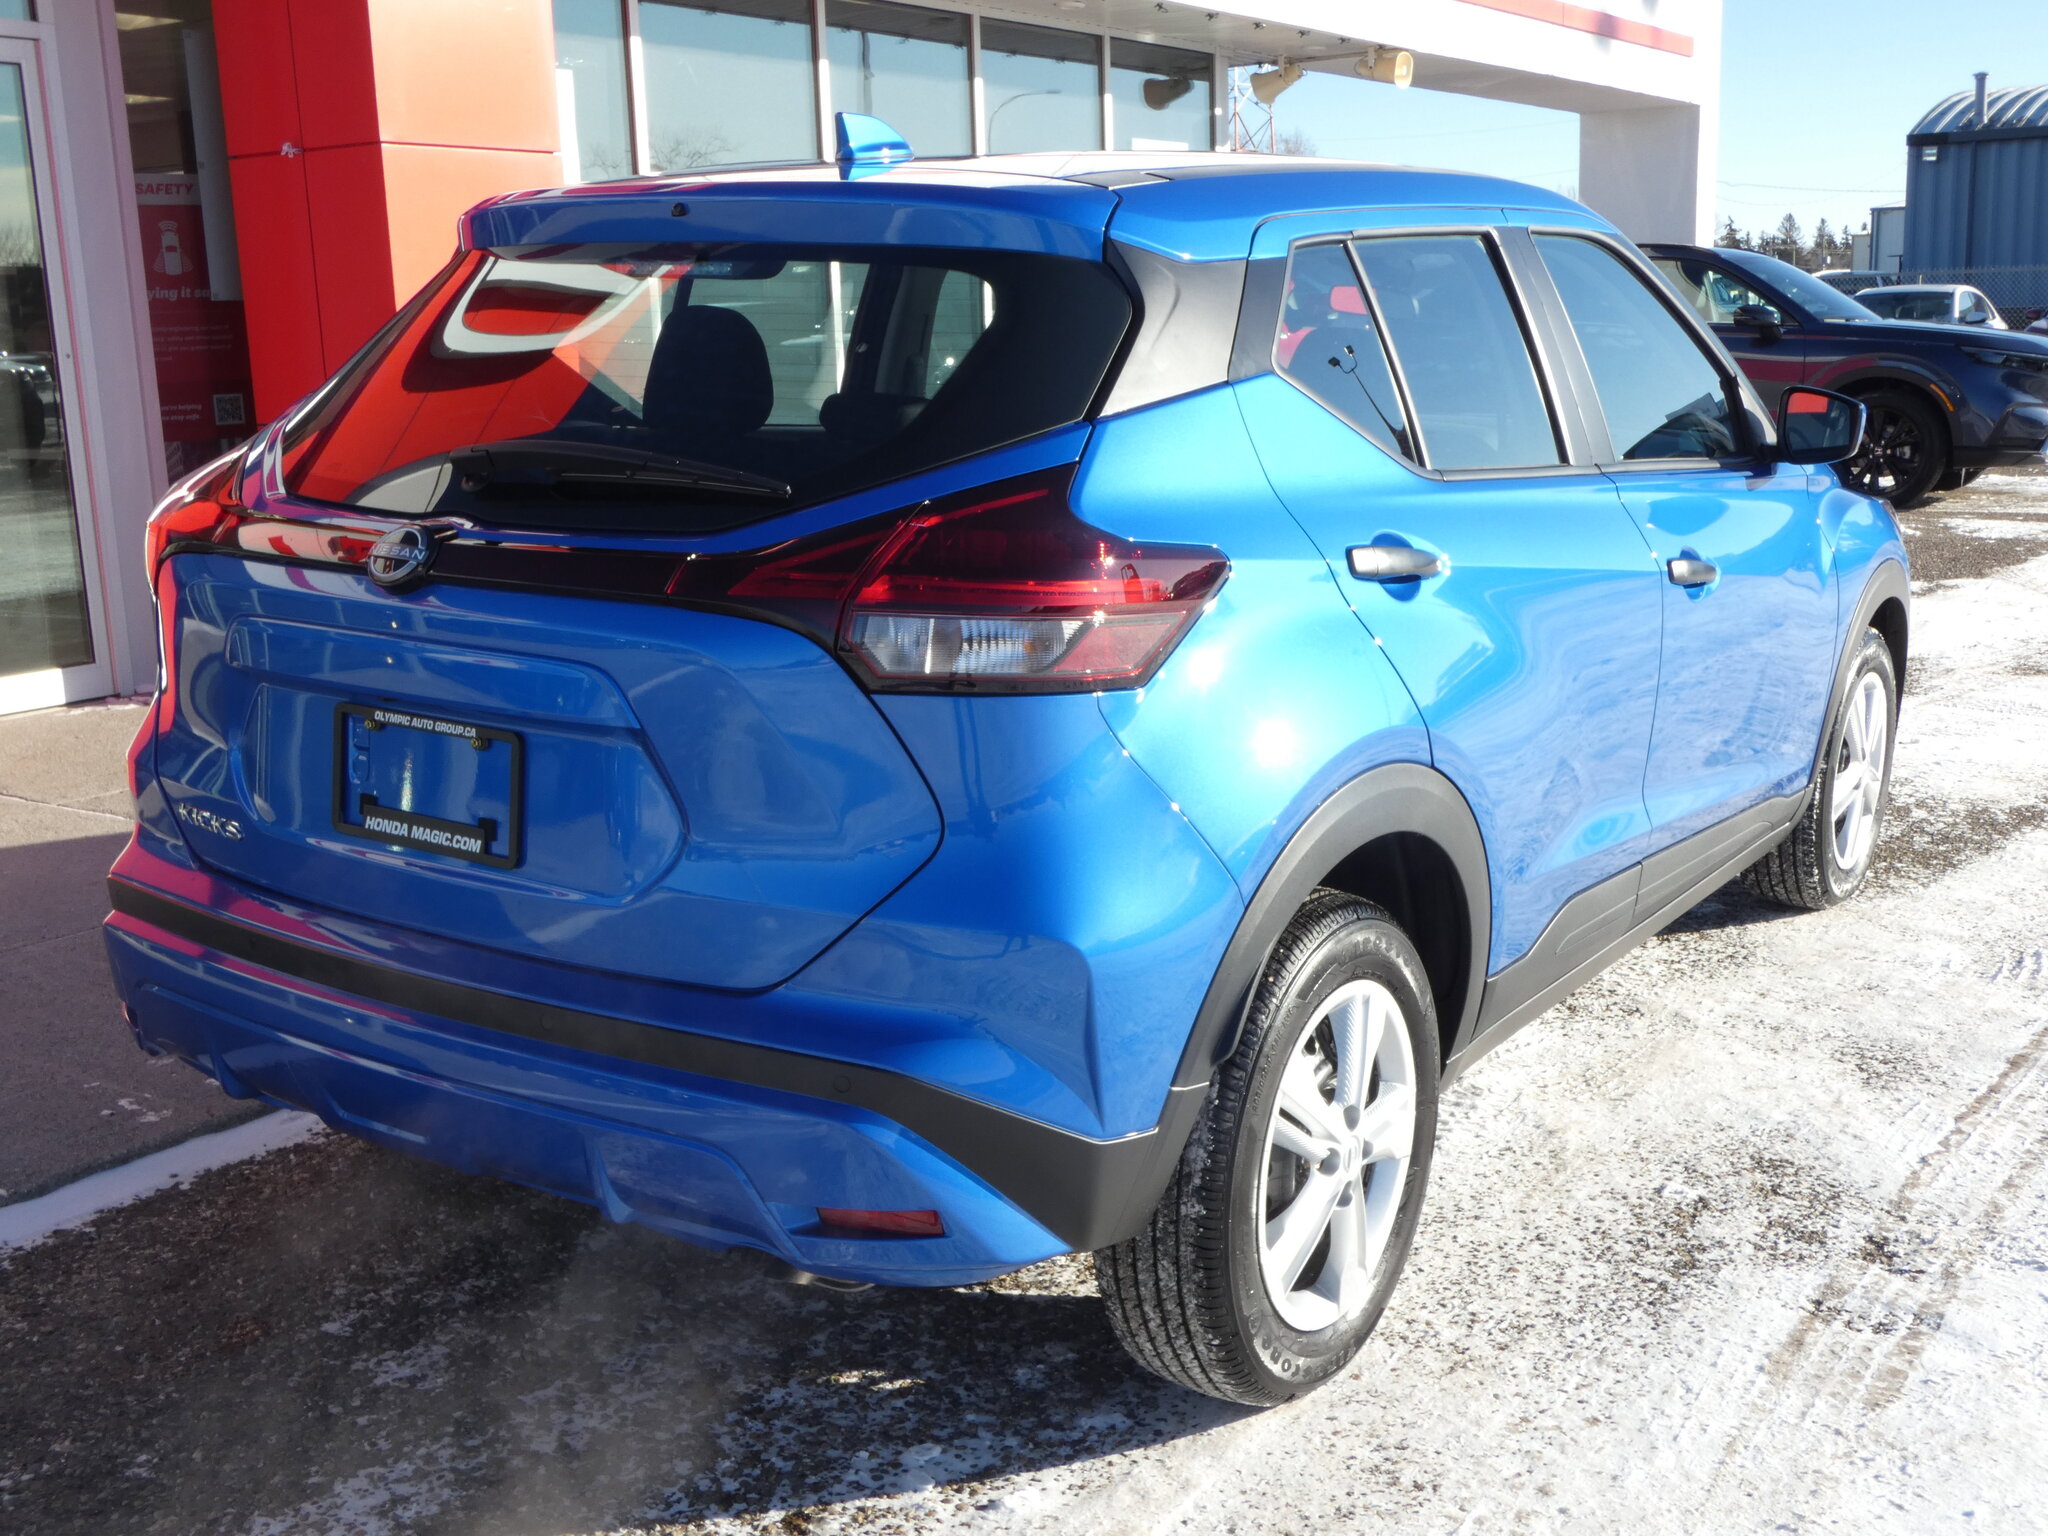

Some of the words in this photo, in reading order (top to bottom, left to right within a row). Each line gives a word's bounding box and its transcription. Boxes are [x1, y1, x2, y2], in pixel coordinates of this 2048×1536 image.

[135, 183, 194, 195] SAFETY
[147, 286, 178, 302] ying
[180, 286, 191, 299] it
[371, 543, 425, 561] NISSAN
[374, 710, 411, 726] OLYMPIC
[410, 718, 434, 730] AUTO
[434, 721, 477, 738] GROUP.CA
[179, 803, 242, 840] KICKS
[364, 815, 409, 838] HONDA
[410, 825, 482, 854] MAGIC.COM
